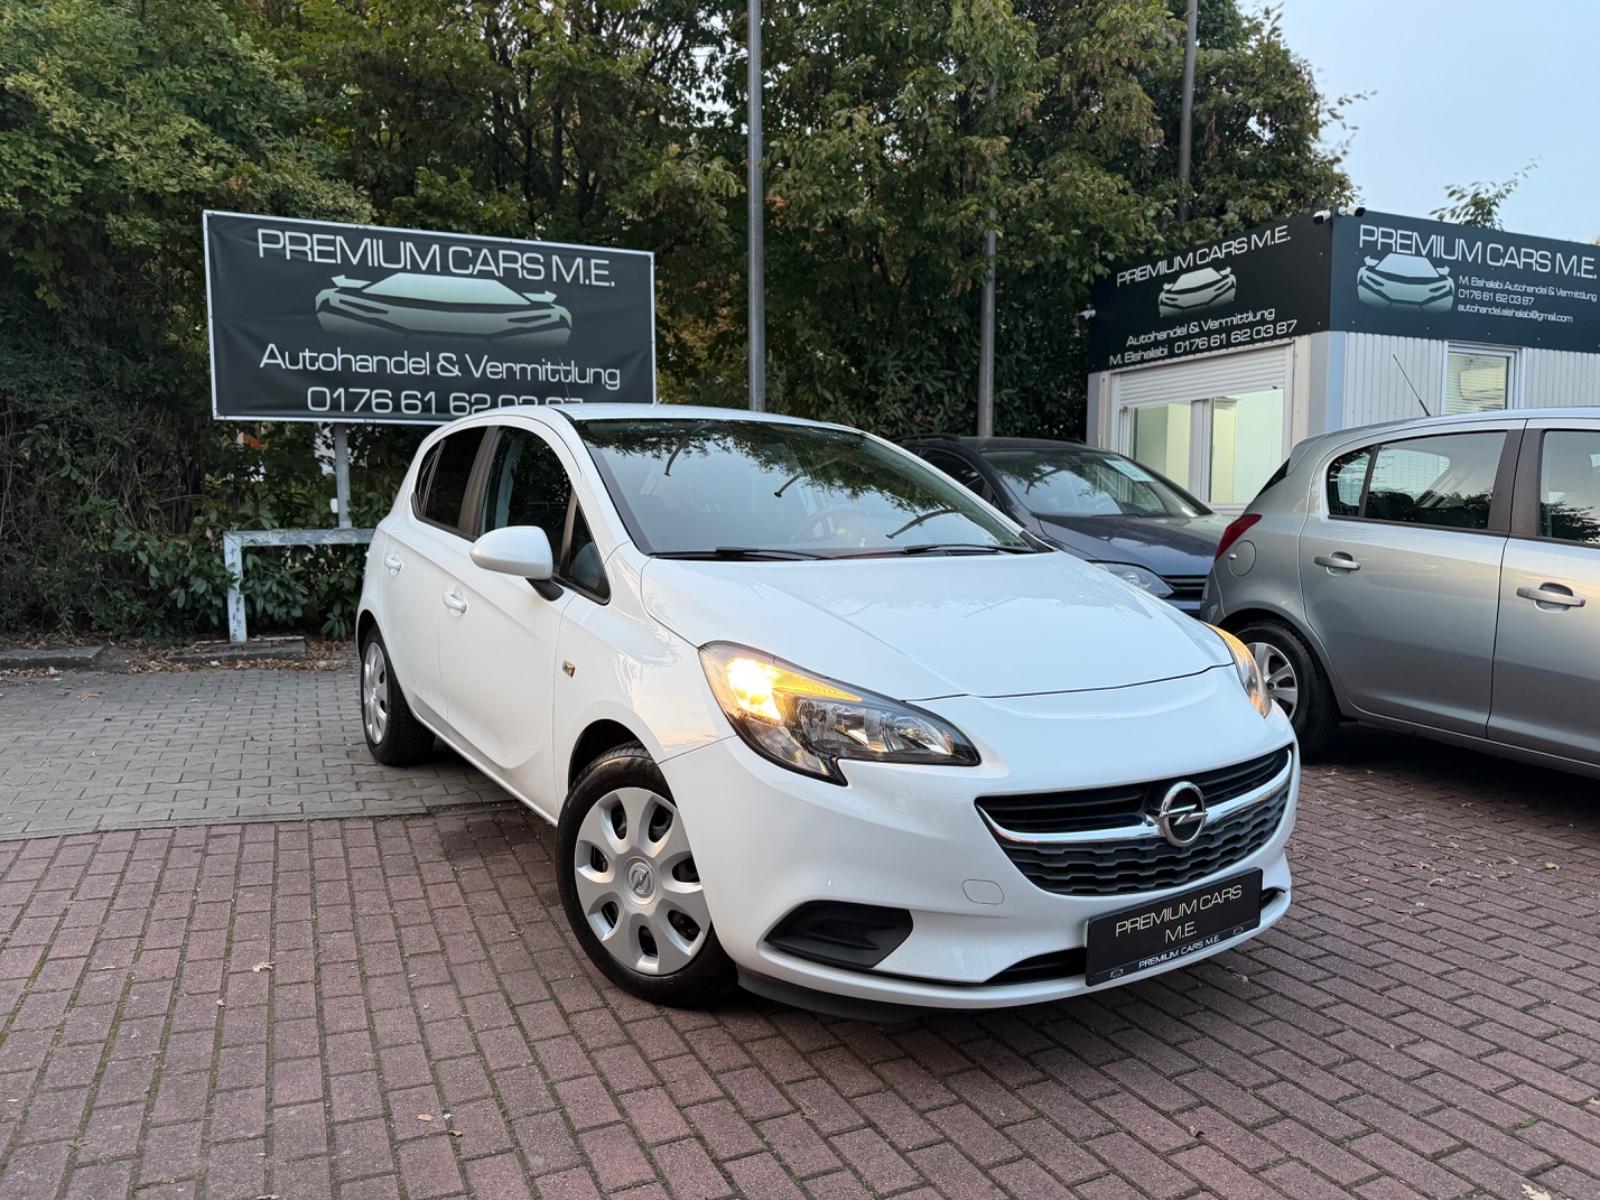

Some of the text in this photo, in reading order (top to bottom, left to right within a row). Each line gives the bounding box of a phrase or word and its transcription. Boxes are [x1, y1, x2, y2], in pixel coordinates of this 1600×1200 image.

[257, 228, 616, 287] PREMIUM CARS M.E.
[1116, 225, 1291, 288] PREMIUM CARS M.E.
[1359, 224, 1598, 279] PREMIUM CARS M.E.
[1458, 288, 1535, 306] 0176 61 62 03 87
[1504, 281, 1547, 295] Autohandel
[1548, 287, 1555, 295] &
[1109, 353, 1123, 366] M.
[1174, 336, 1208, 354] 0176
[1210, 333, 1226, 347] 61
[1230, 327, 1250, 343] 62
[1253, 324, 1273, 339] 03
[1276, 319, 1298, 335] 87
[1126, 308, 1275, 347] Autohandel & Vermittlung
[260, 342, 621, 390] Autohandel & Vermittlung
[307, 386, 393, 415] 0176
[401, 389, 437, 415] 61
[449, 392, 491, 416] 62
[1115, 884, 1243, 938] PREMIUM CARS
[1165, 921, 1198, 943] M.E.
[1138, 934, 1221, 969] PREMIUM CARS M.E.
